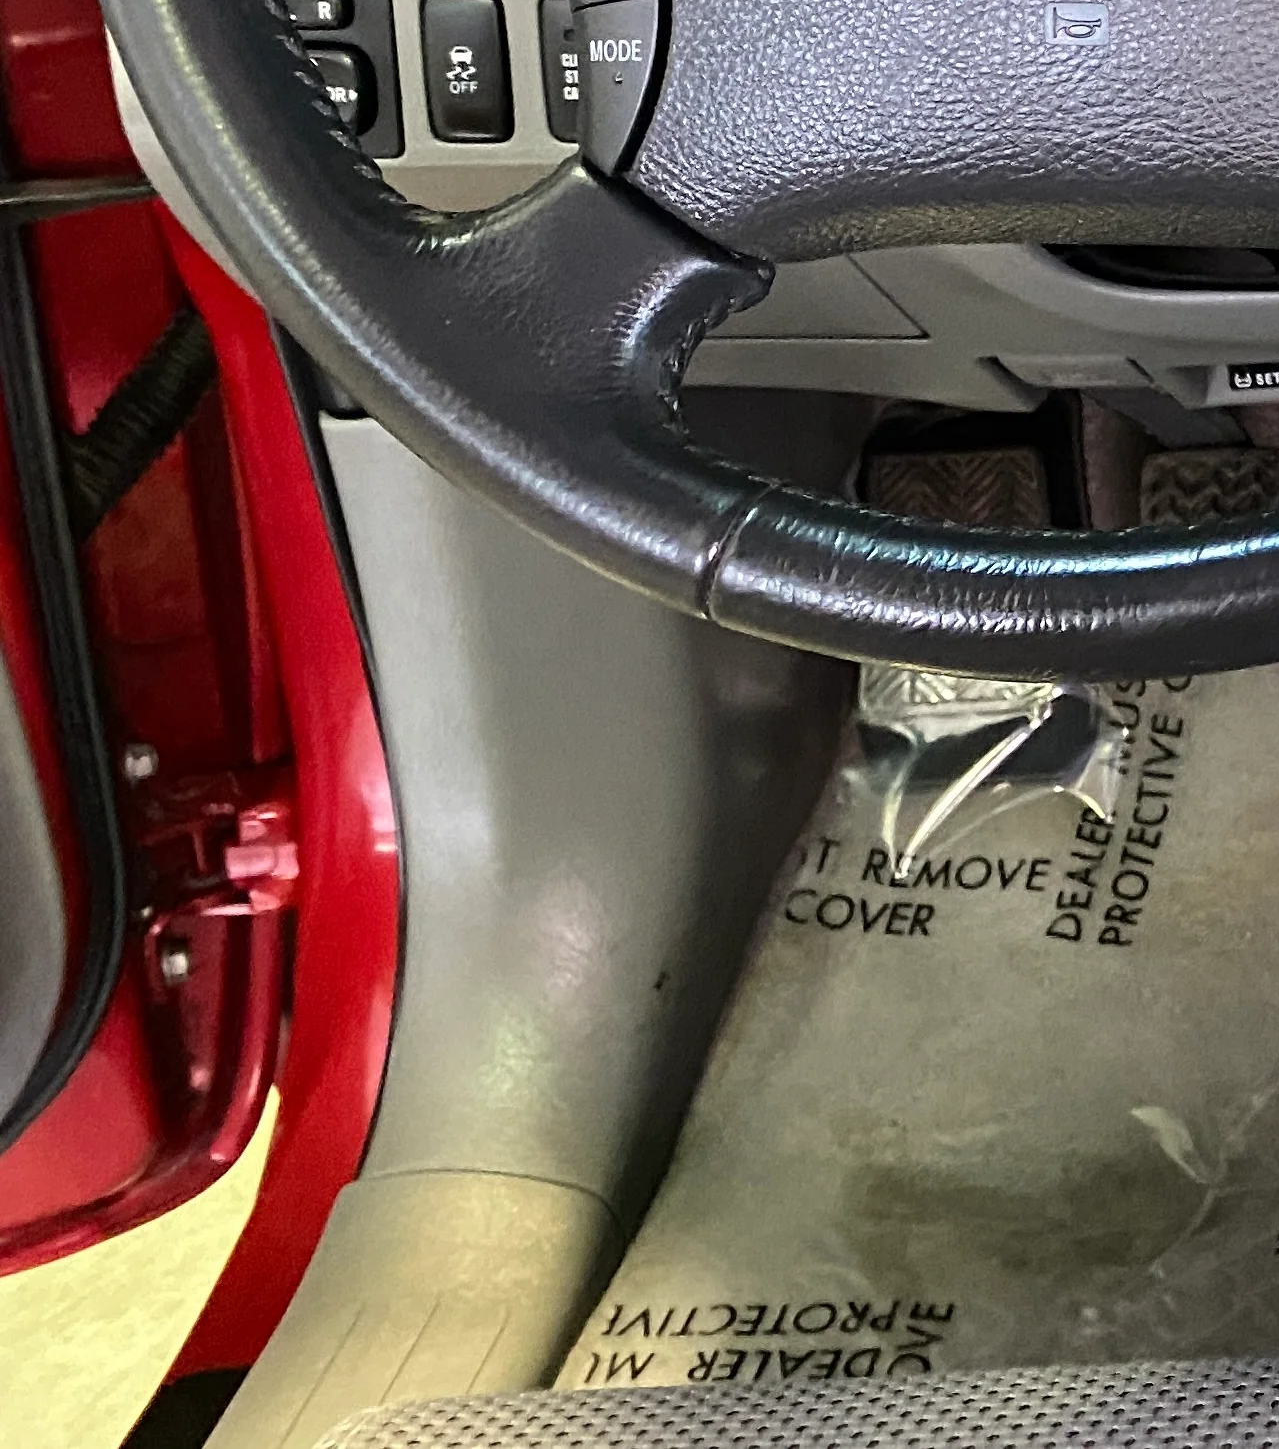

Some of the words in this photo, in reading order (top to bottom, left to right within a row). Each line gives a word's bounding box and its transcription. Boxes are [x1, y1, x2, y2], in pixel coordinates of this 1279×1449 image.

[318, 1, 331, 20] R
[589, 40, 643, 62] MODE
[449, 81, 478, 94] OFF
[1099, 715, 1184, 947] PROTECTIVE
[861, 849, 1052, 892] REMOVE
[784, 890, 936, 937] COVER
[687, 1348, 882, 1382] DEALER
